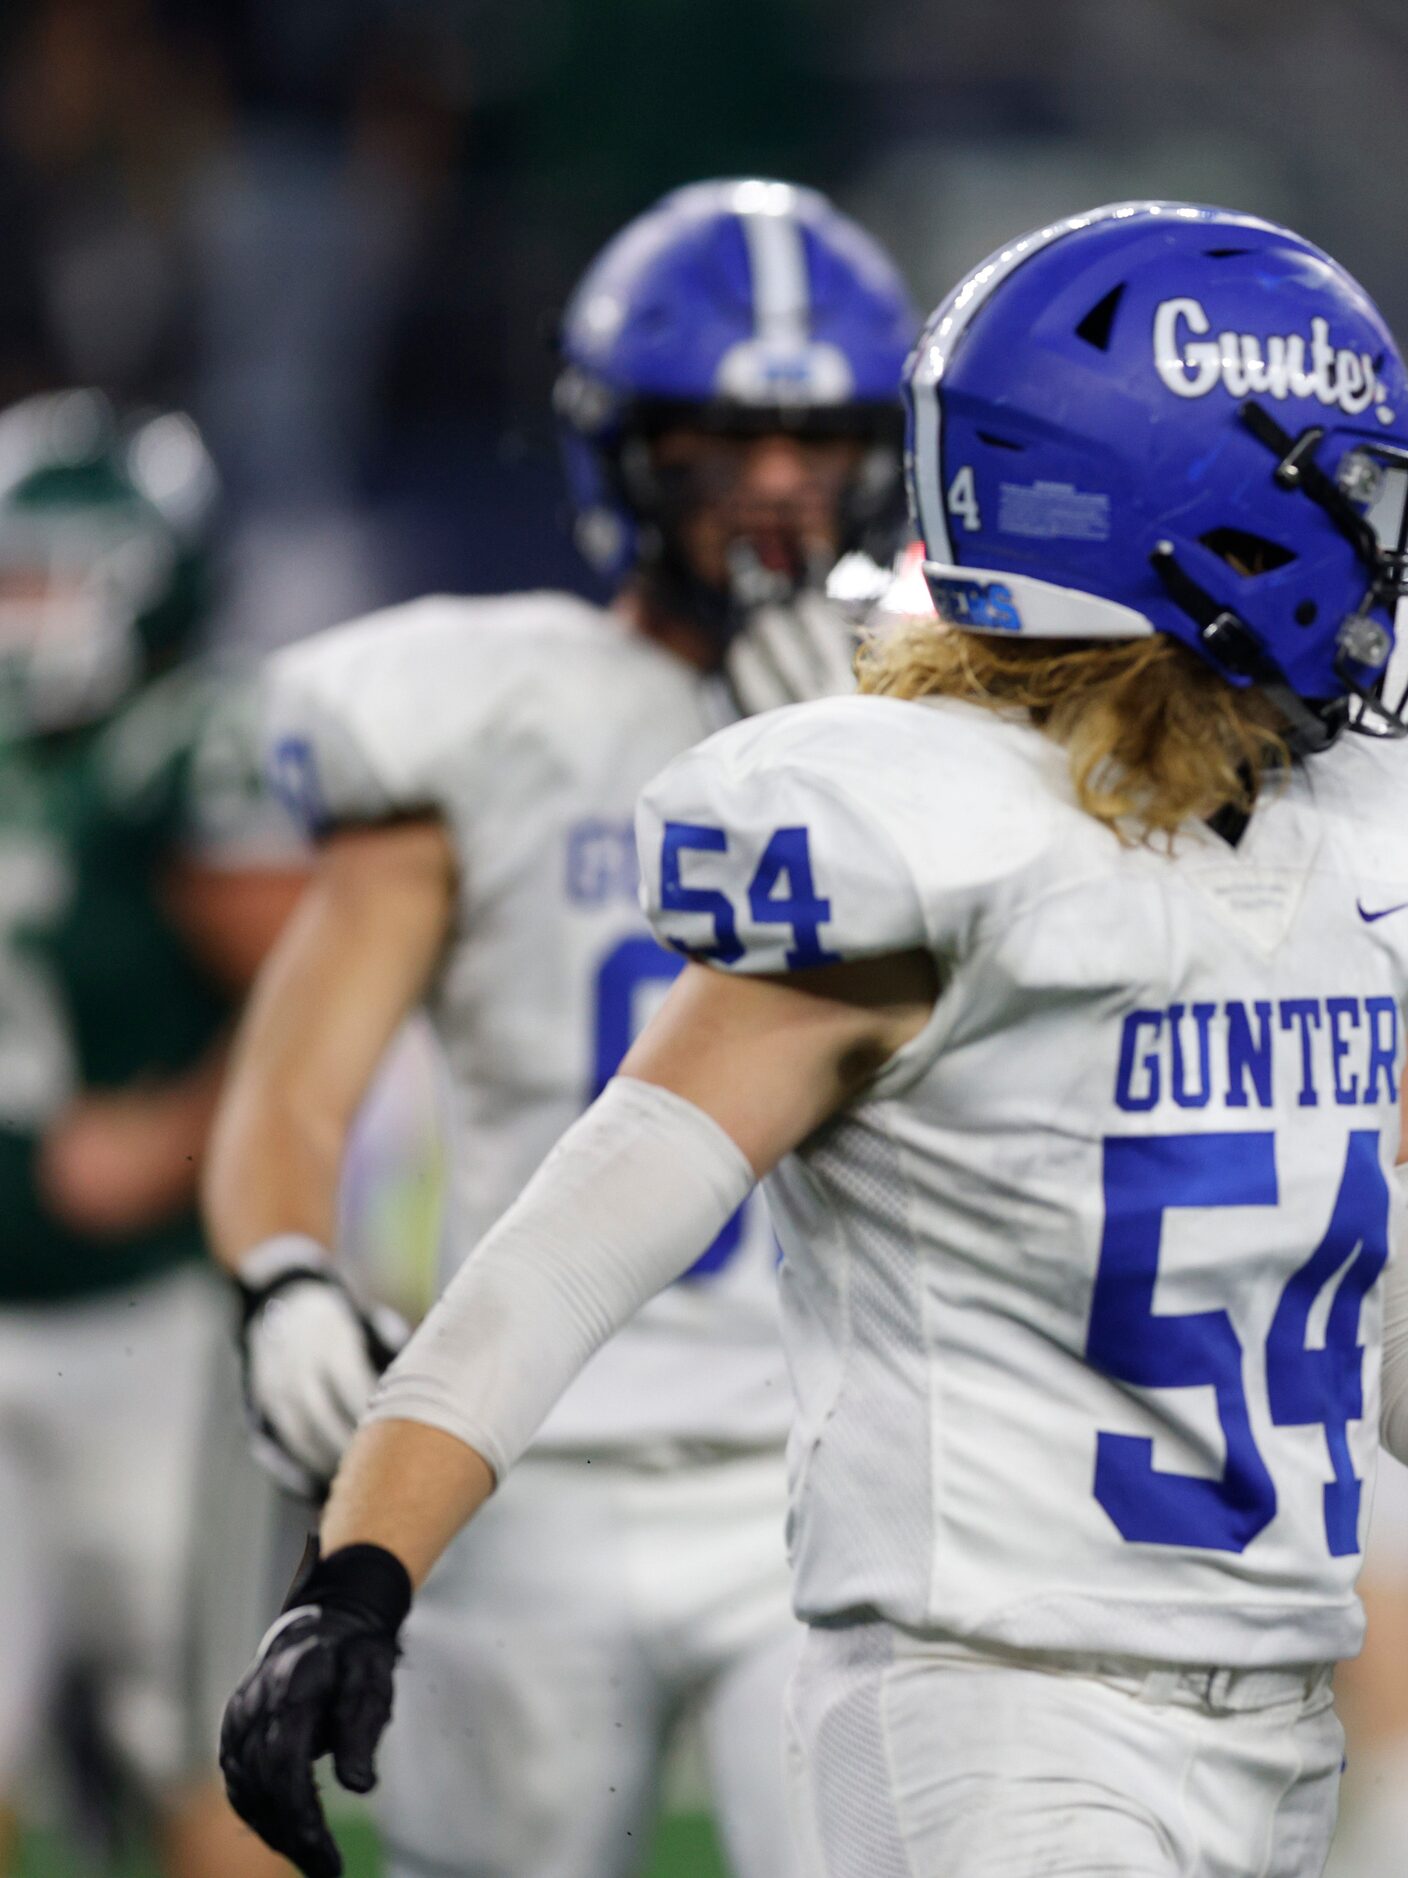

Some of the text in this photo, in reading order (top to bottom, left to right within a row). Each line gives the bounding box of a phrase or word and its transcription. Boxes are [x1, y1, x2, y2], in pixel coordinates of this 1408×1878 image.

[658, 820, 844, 970] 54
[1115, 994, 1400, 1112] GUNTER
[1086, 1129, 1390, 1558] 54
